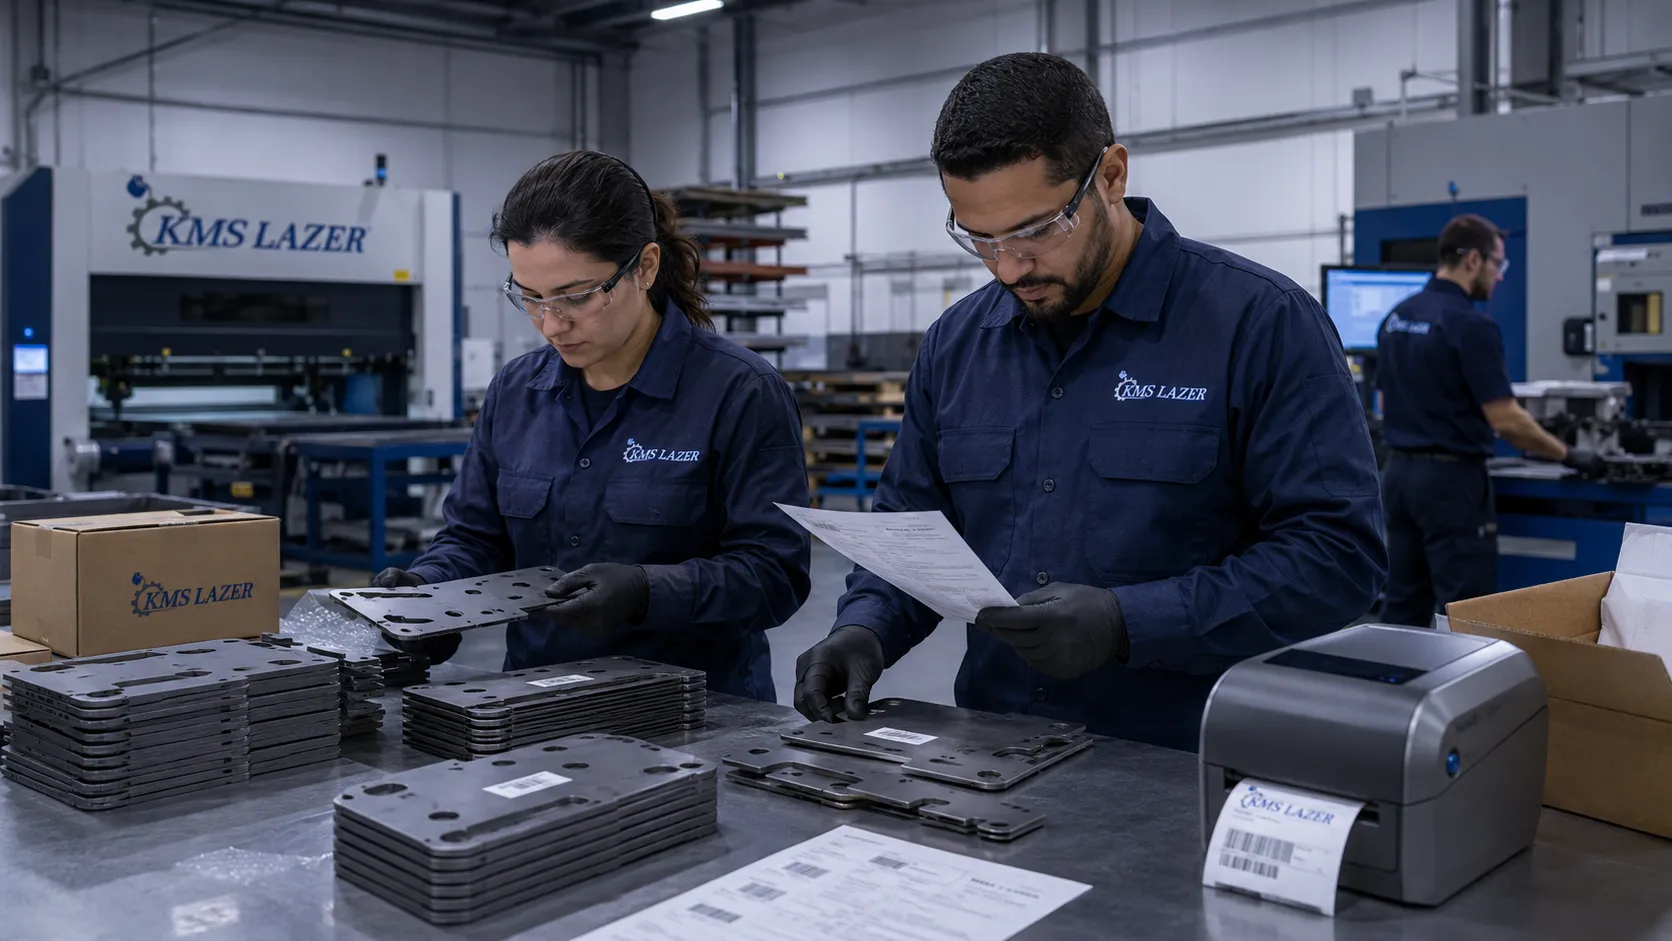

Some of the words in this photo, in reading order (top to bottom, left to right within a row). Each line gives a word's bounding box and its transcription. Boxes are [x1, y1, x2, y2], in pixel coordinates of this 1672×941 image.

[152, 215, 248, 248] KMS
[252, 221, 367, 253] LAZER
[1121, 384, 1156, 397] KMS
[1156, 385, 1207, 400] LAZER
[630, 449, 658, 460] KMS
[658, 449, 700, 461] LAZER
[142, 588, 191, 610] KMS
[193, 582, 254, 605] LAZER
[1248, 796, 1283, 812] KMS
[1284, 804, 1335, 825] LAZER
